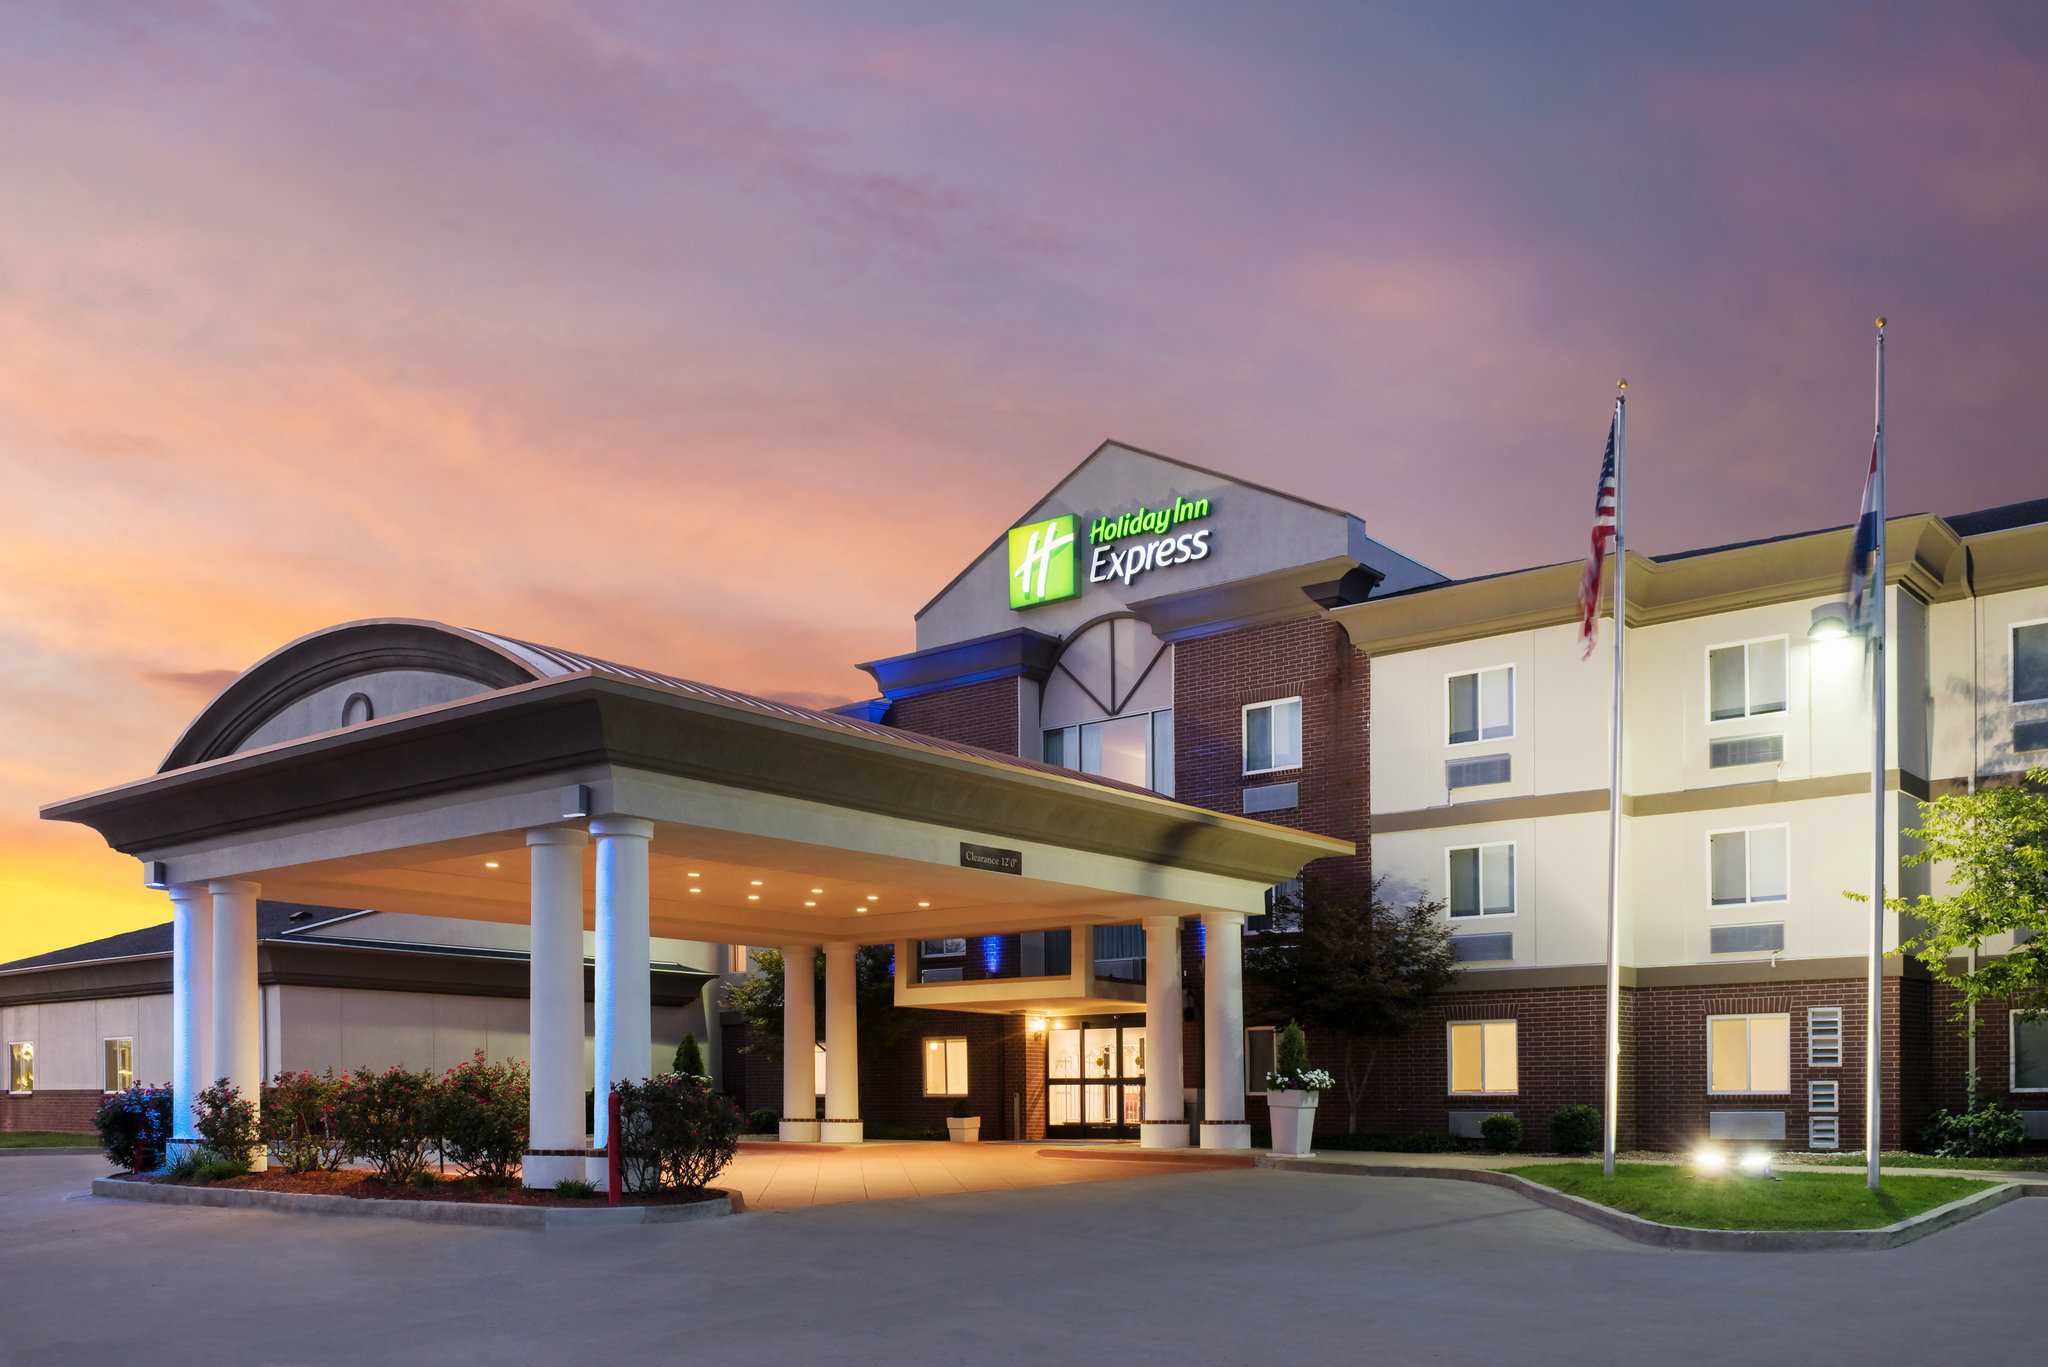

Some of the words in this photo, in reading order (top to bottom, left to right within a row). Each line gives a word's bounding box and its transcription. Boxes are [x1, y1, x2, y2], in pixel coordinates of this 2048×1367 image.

[1089, 506, 1171, 545] Holiday
[1173, 496, 1210, 524] Inn
[1015, 522, 1074, 598] H
[1089, 530, 1210, 585] Express
[966, 850, 999, 865] Clearance
